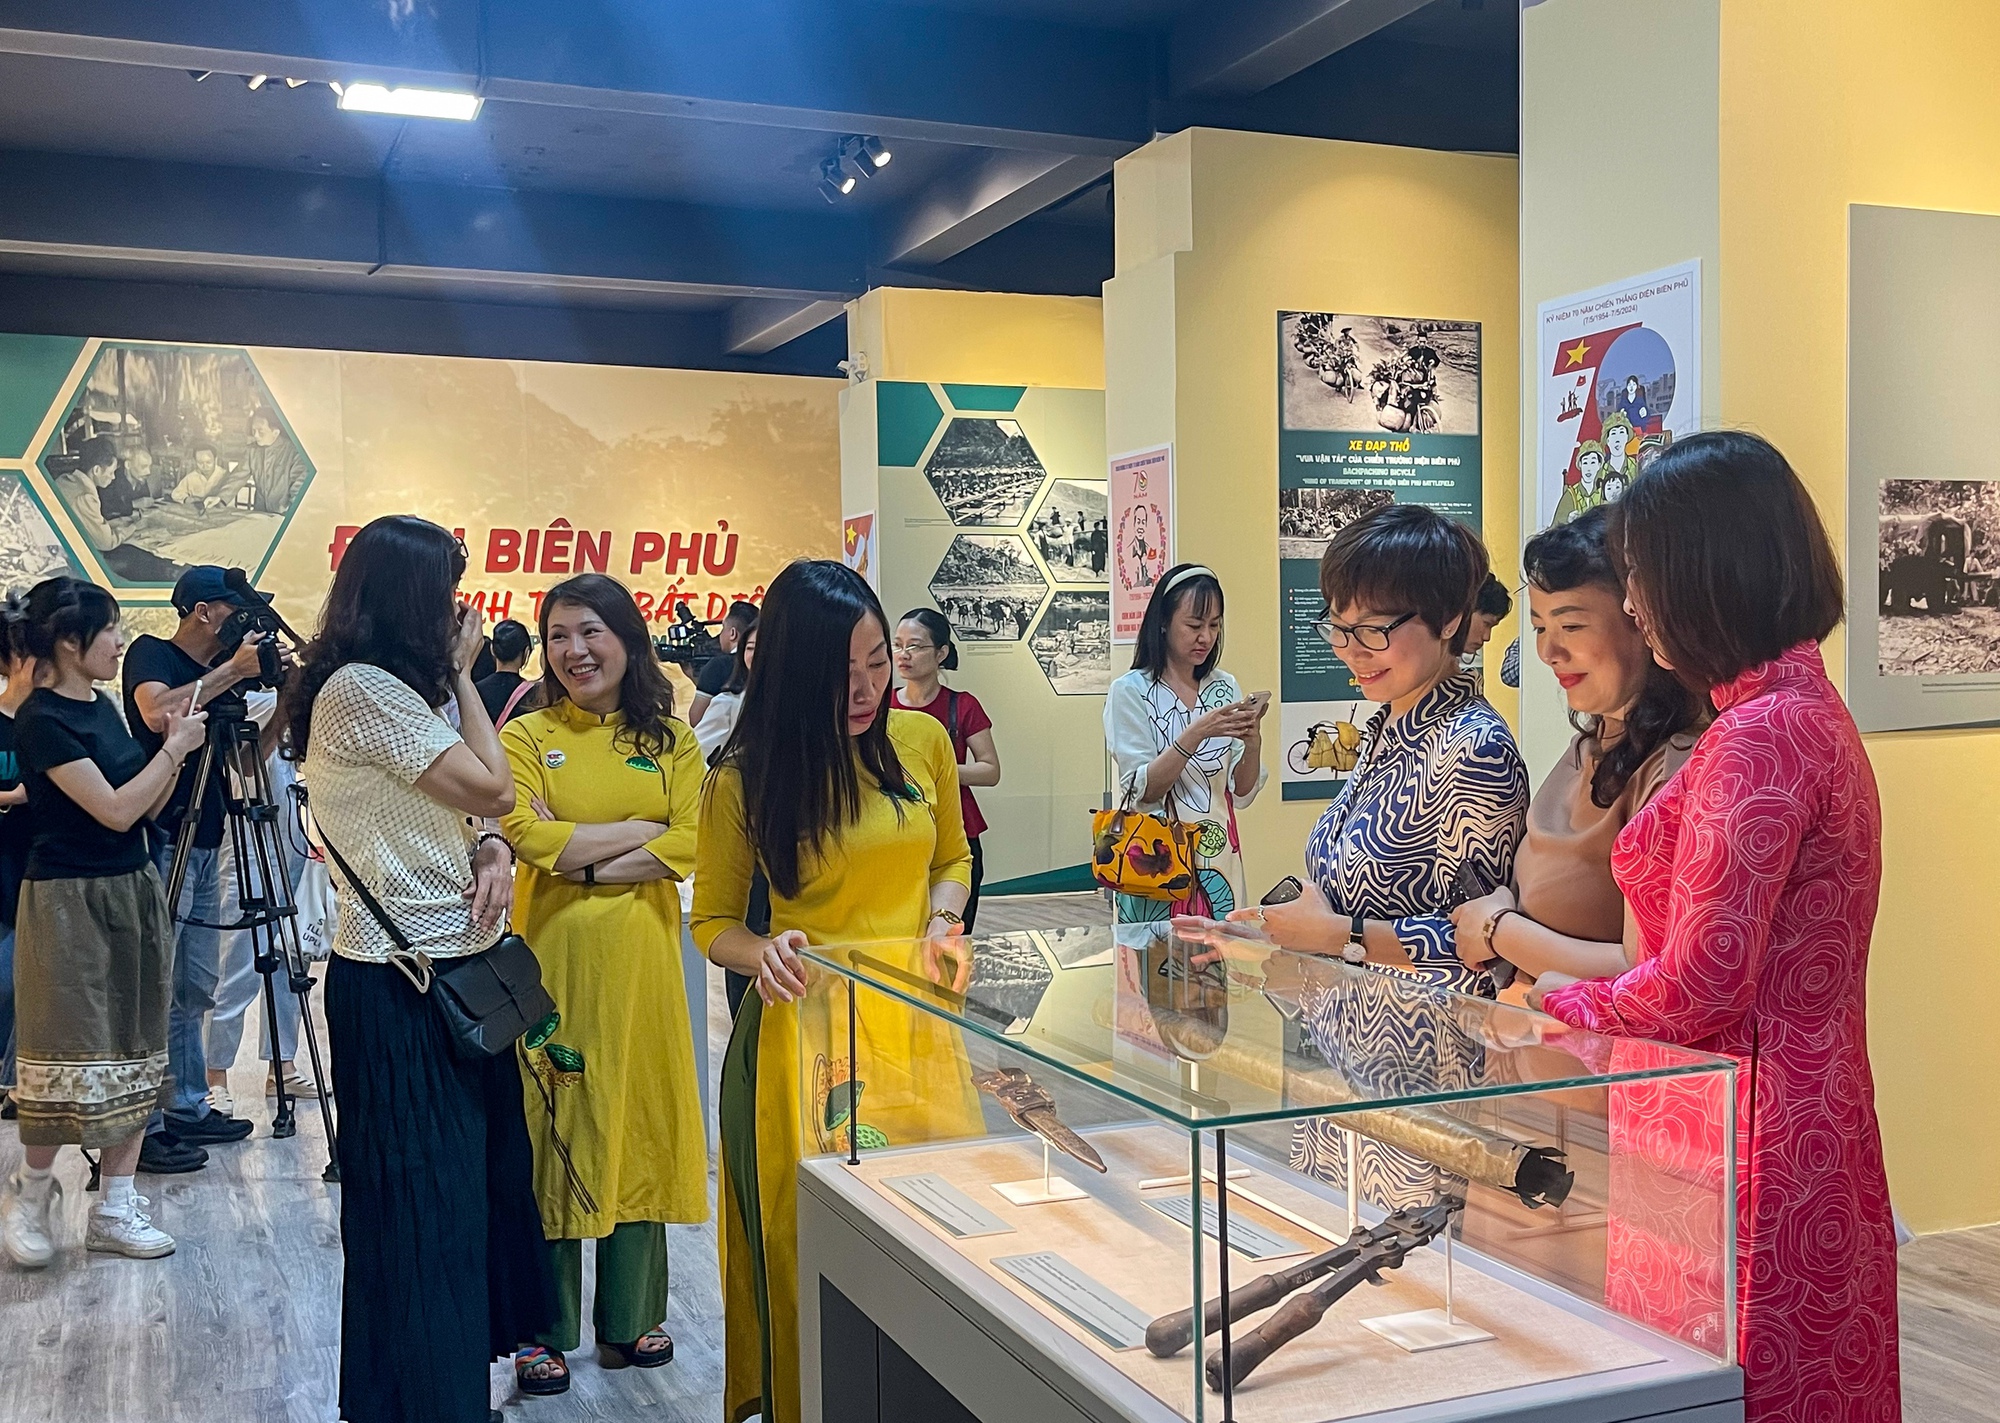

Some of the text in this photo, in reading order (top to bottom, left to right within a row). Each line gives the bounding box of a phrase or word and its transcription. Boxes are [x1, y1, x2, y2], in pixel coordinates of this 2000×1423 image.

[1572, 309, 1579, 317] 70
[1348, 440, 1363, 451] XE
[1365, 440, 1387, 454] ĐẠP
[1348, 453, 1362, 464] CỦA
[1447, 456, 1461, 466] PHỦ
[1390, 468, 1416, 477] BICYCLE
[485, 517, 611, 574] BIÊN
[630, 519, 739, 577] PHỦ
